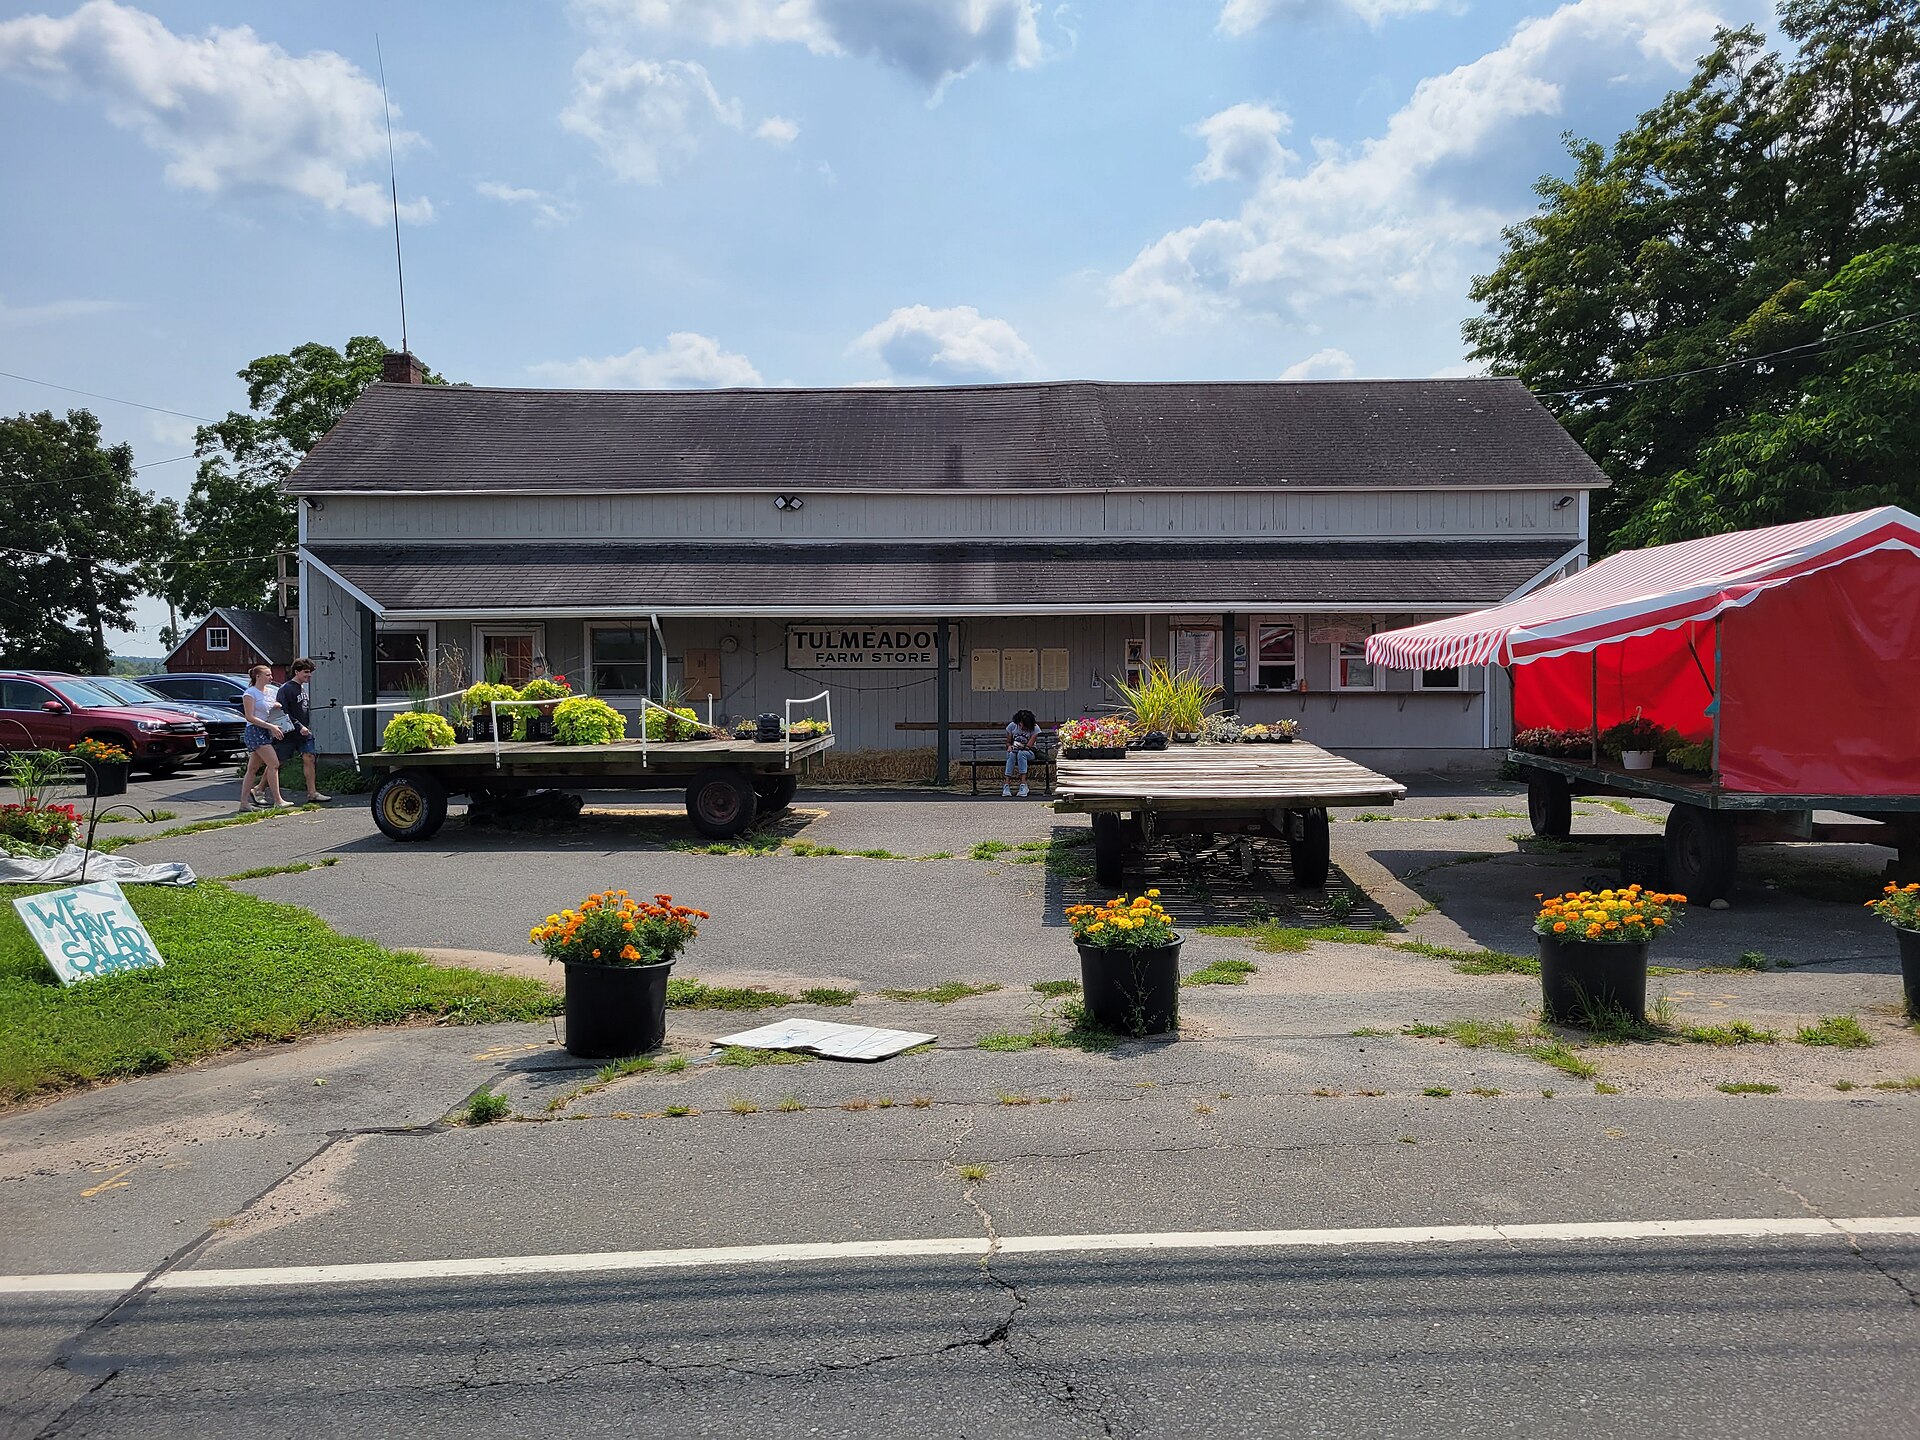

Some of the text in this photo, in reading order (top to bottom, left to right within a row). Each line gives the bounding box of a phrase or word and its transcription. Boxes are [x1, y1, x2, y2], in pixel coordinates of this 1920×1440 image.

[815, 652, 931, 663] FARM STORE
[26, 893, 91, 928] WE
[65, 910, 117, 942] HAVE
[61, 926, 146, 972] SALAD
